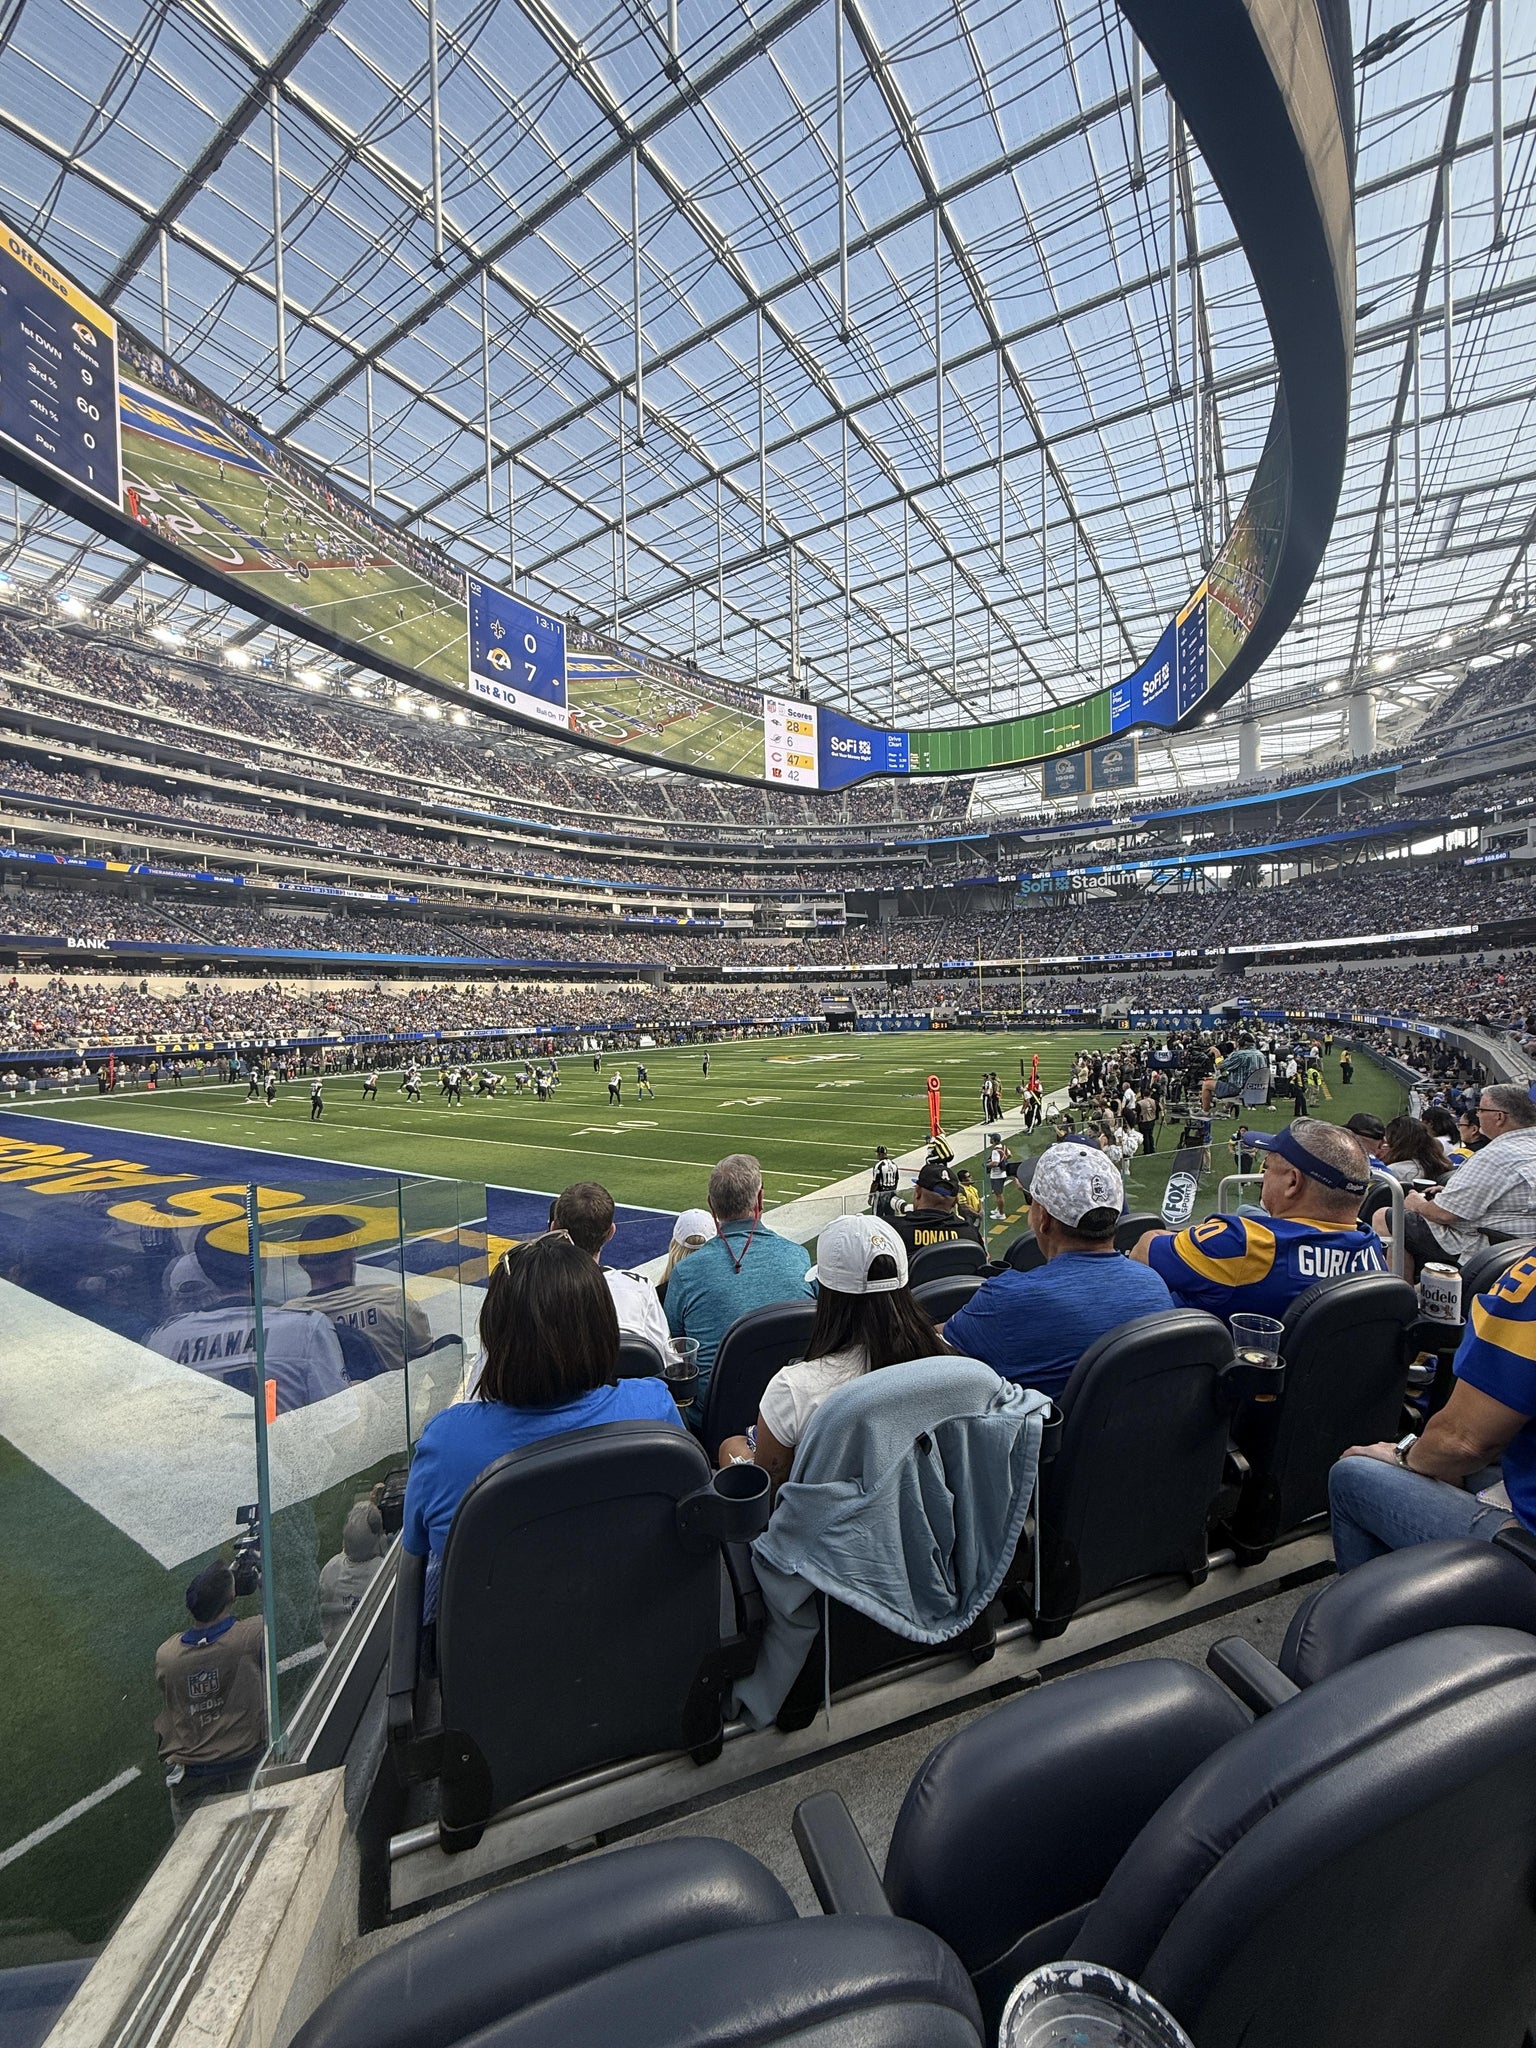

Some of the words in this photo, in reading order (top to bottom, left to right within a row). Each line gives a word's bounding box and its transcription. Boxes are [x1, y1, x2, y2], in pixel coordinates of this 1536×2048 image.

[8, 237, 69, 297] Offense
[20, 321, 35, 341] 1st
[35, 333, 62, 360] DWN
[73, 342, 99, 368] Rams
[28, 361, 47, 382] 3rd
[81, 368, 93, 386] 9
[30, 397, 48, 416] 4th
[77, 396, 100, 421] 60
[35, 433, 56, 453] Pen
[83, 432, 96, 450] 0
[87, 465, 94, 480] 1
[535, 615, 560, 634] 13:11
[523, 633, 537, 654] 0
[524, 661, 537, 682] 7
[474, 679, 491, 696] 1st
[492, 687, 501, 699] &
[503, 690, 516, 705] 10
[1142, 670, 1163, 698] SoFi
[787, 708, 813, 721] Scores
[786, 720, 800, 733] 28
[786, 736, 794, 748] 6
[831, 736, 857, 753] SoFi
[786, 754, 800, 767] 47
[787, 770, 800, 782] 42
[1103, 766, 1123, 774] 2021
[1020, 879, 1053, 894] SoFi
[1071, 871, 1137, 890] Stadium
[67, 937, 110, 949] BANK.
[1204, 948, 1218, 956] SoFi
[1176, 949, 1190, 957] SoFi
[156, 1042, 215, 1053] RAMS
[227, 1040, 289, 1049] HOUSE
[569, 1119, 660, 1137] 10
[1164, 1182, 1187, 1212] FOX
[1180, 1183, 1193, 1213] SPORTS
[914, 1229, 959, 1246] DONALD
[192, 1680, 217, 1694] NFL
[189, 1697, 224, 1715] MEDIA
